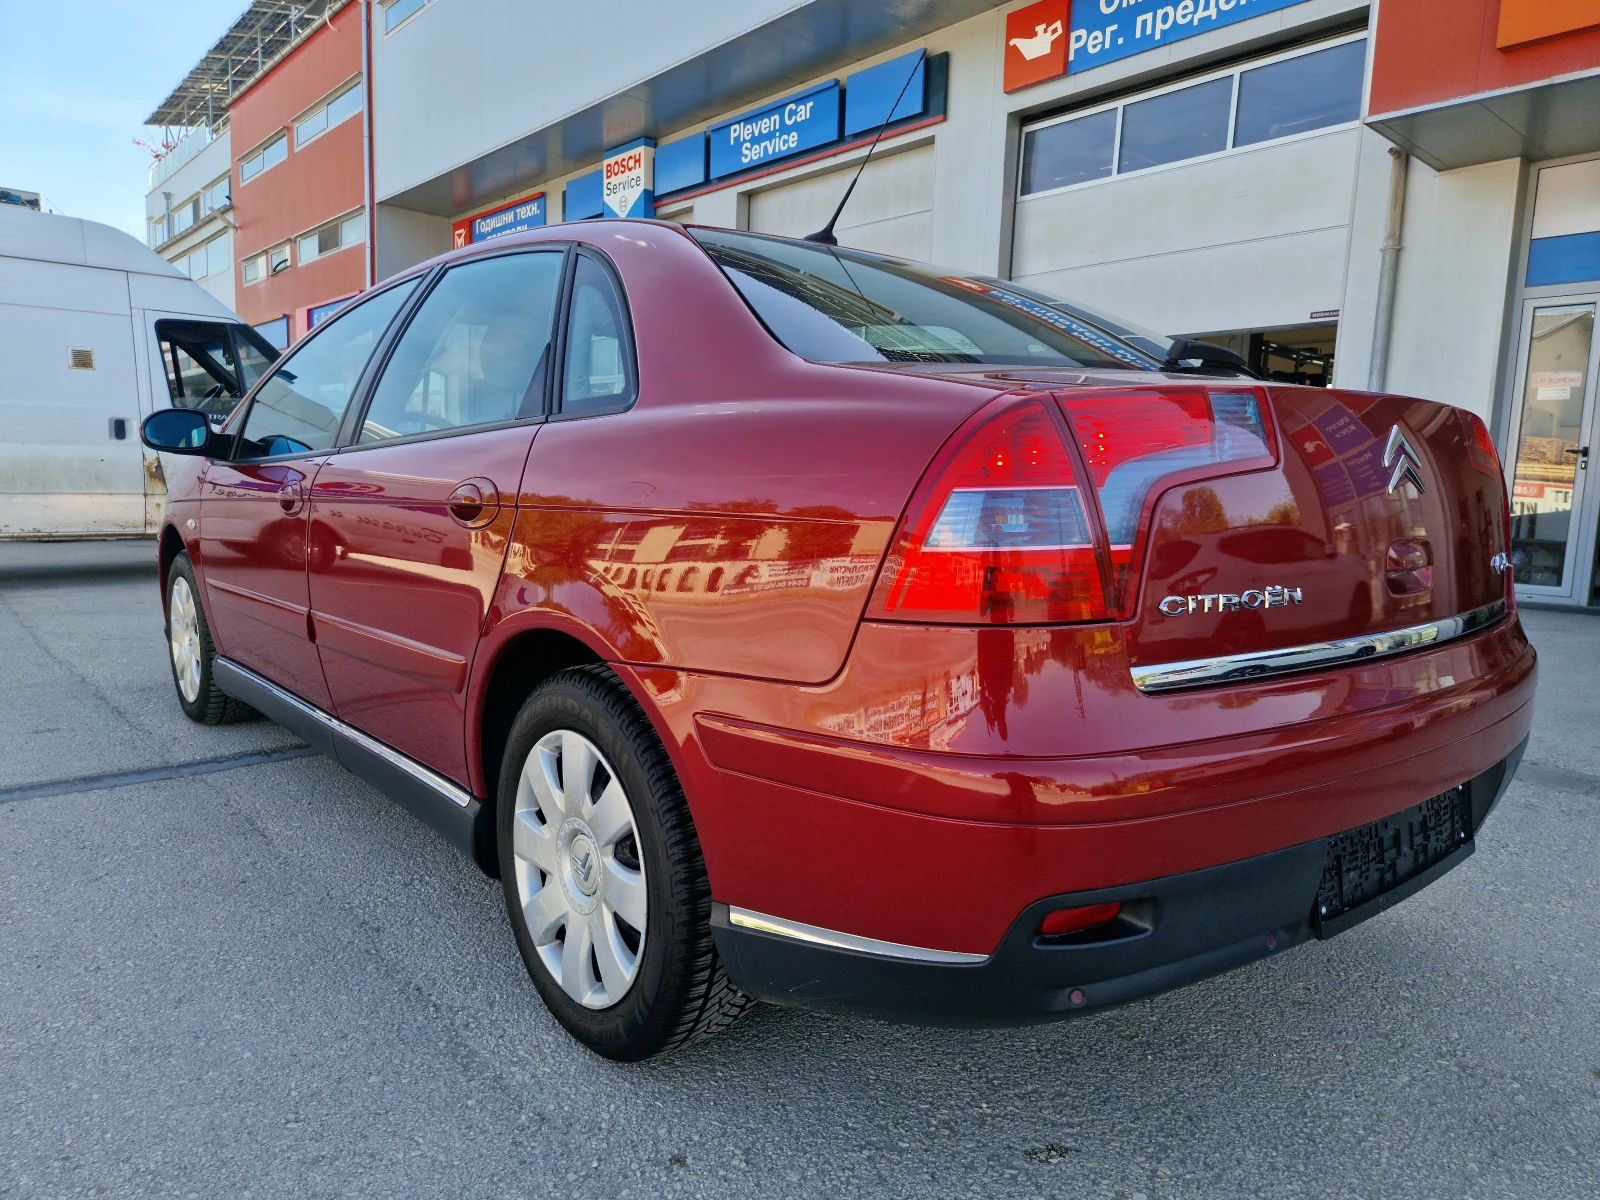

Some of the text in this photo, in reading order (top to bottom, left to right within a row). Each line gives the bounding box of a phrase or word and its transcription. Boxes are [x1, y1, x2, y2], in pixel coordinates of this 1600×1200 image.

[1068, 0, 1257, 61] Рег. пред
[730, 101, 814, 145] Pleven Car
[741, 131, 798, 164] Service
[605, 152, 642, 180] BOSCH
[605, 175, 641, 197] Service
[475, 210, 514, 235] Годишни
[516, 202, 540, 220] техн.
[1158, 585, 1303, 617] CITROËN
